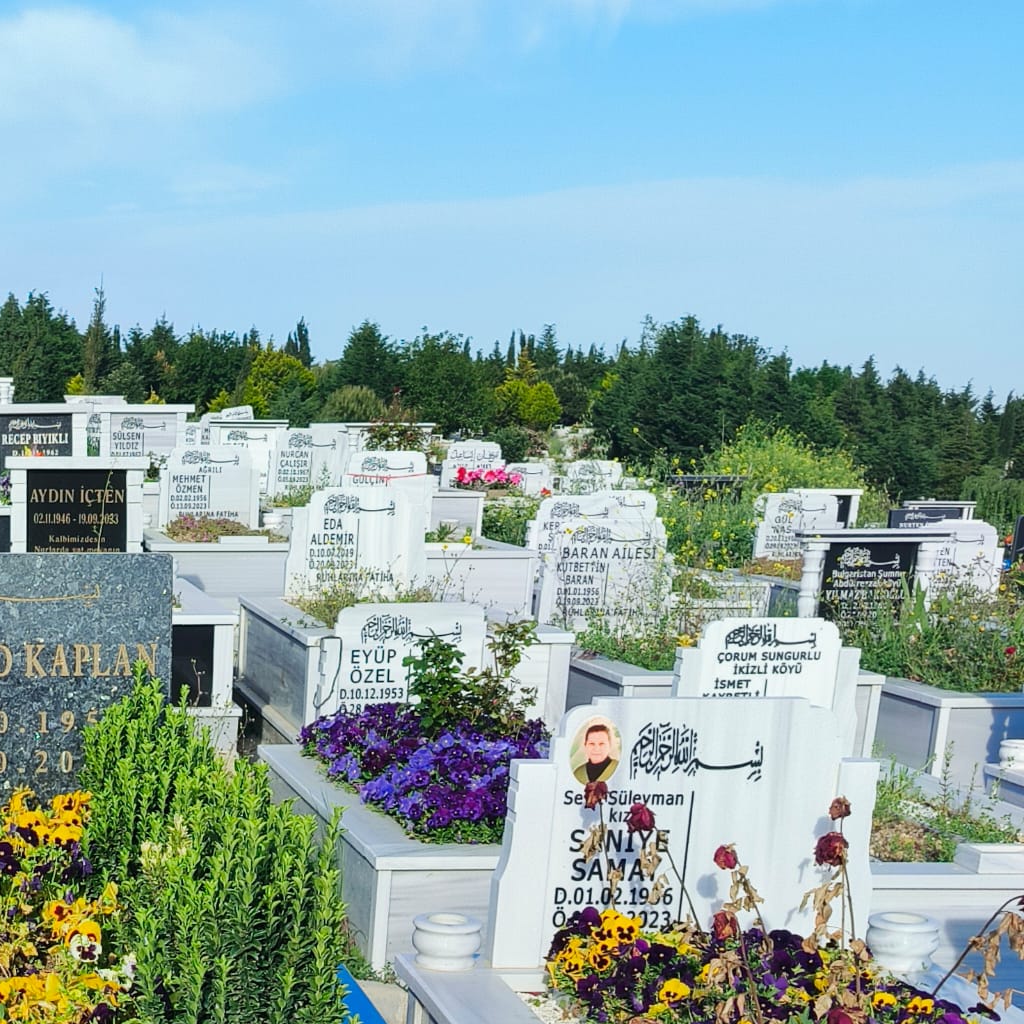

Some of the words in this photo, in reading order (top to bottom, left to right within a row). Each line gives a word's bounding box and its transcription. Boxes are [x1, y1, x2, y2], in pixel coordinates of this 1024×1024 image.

[1, 433, 31, 445] RECEP
[33, 432, 68, 444] BIYIKLI
[172, 474, 207, 484] MEHMET
[175, 484, 203, 494] ÖZMEN
[30, 488, 75, 504] AYDIN
[79, 485, 125, 507] İÇTEN
[33, 513, 71, 525] 02.11.1946
[323, 518, 343, 531] EDA
[49, 534, 106, 543] Kalbimizdesn
[310, 532, 354, 545] ALDEMİR
[561, 547, 609, 559] BARAN
[611, 544, 657, 559] AİLESİ
[565, 575, 594, 585] BARAN
[25, 643, 158, 678] KAPLAN
[351, 645, 397, 664] EYÜP
[717, 652, 757, 664] ÇORUM
[761, 651, 822, 661] SUNGURLU
[350, 665, 396, 684] ÖZEL
[733, 663, 768, 675] İKİZLİ
[772, 662, 803, 675] KÖYÜ
[714, 677, 751, 689] İSMET
[339, 687, 404, 700] D.10.12.1953
[608, 790, 684, 806] Süleyman
[554, 887, 674, 905] D.01.02.196
